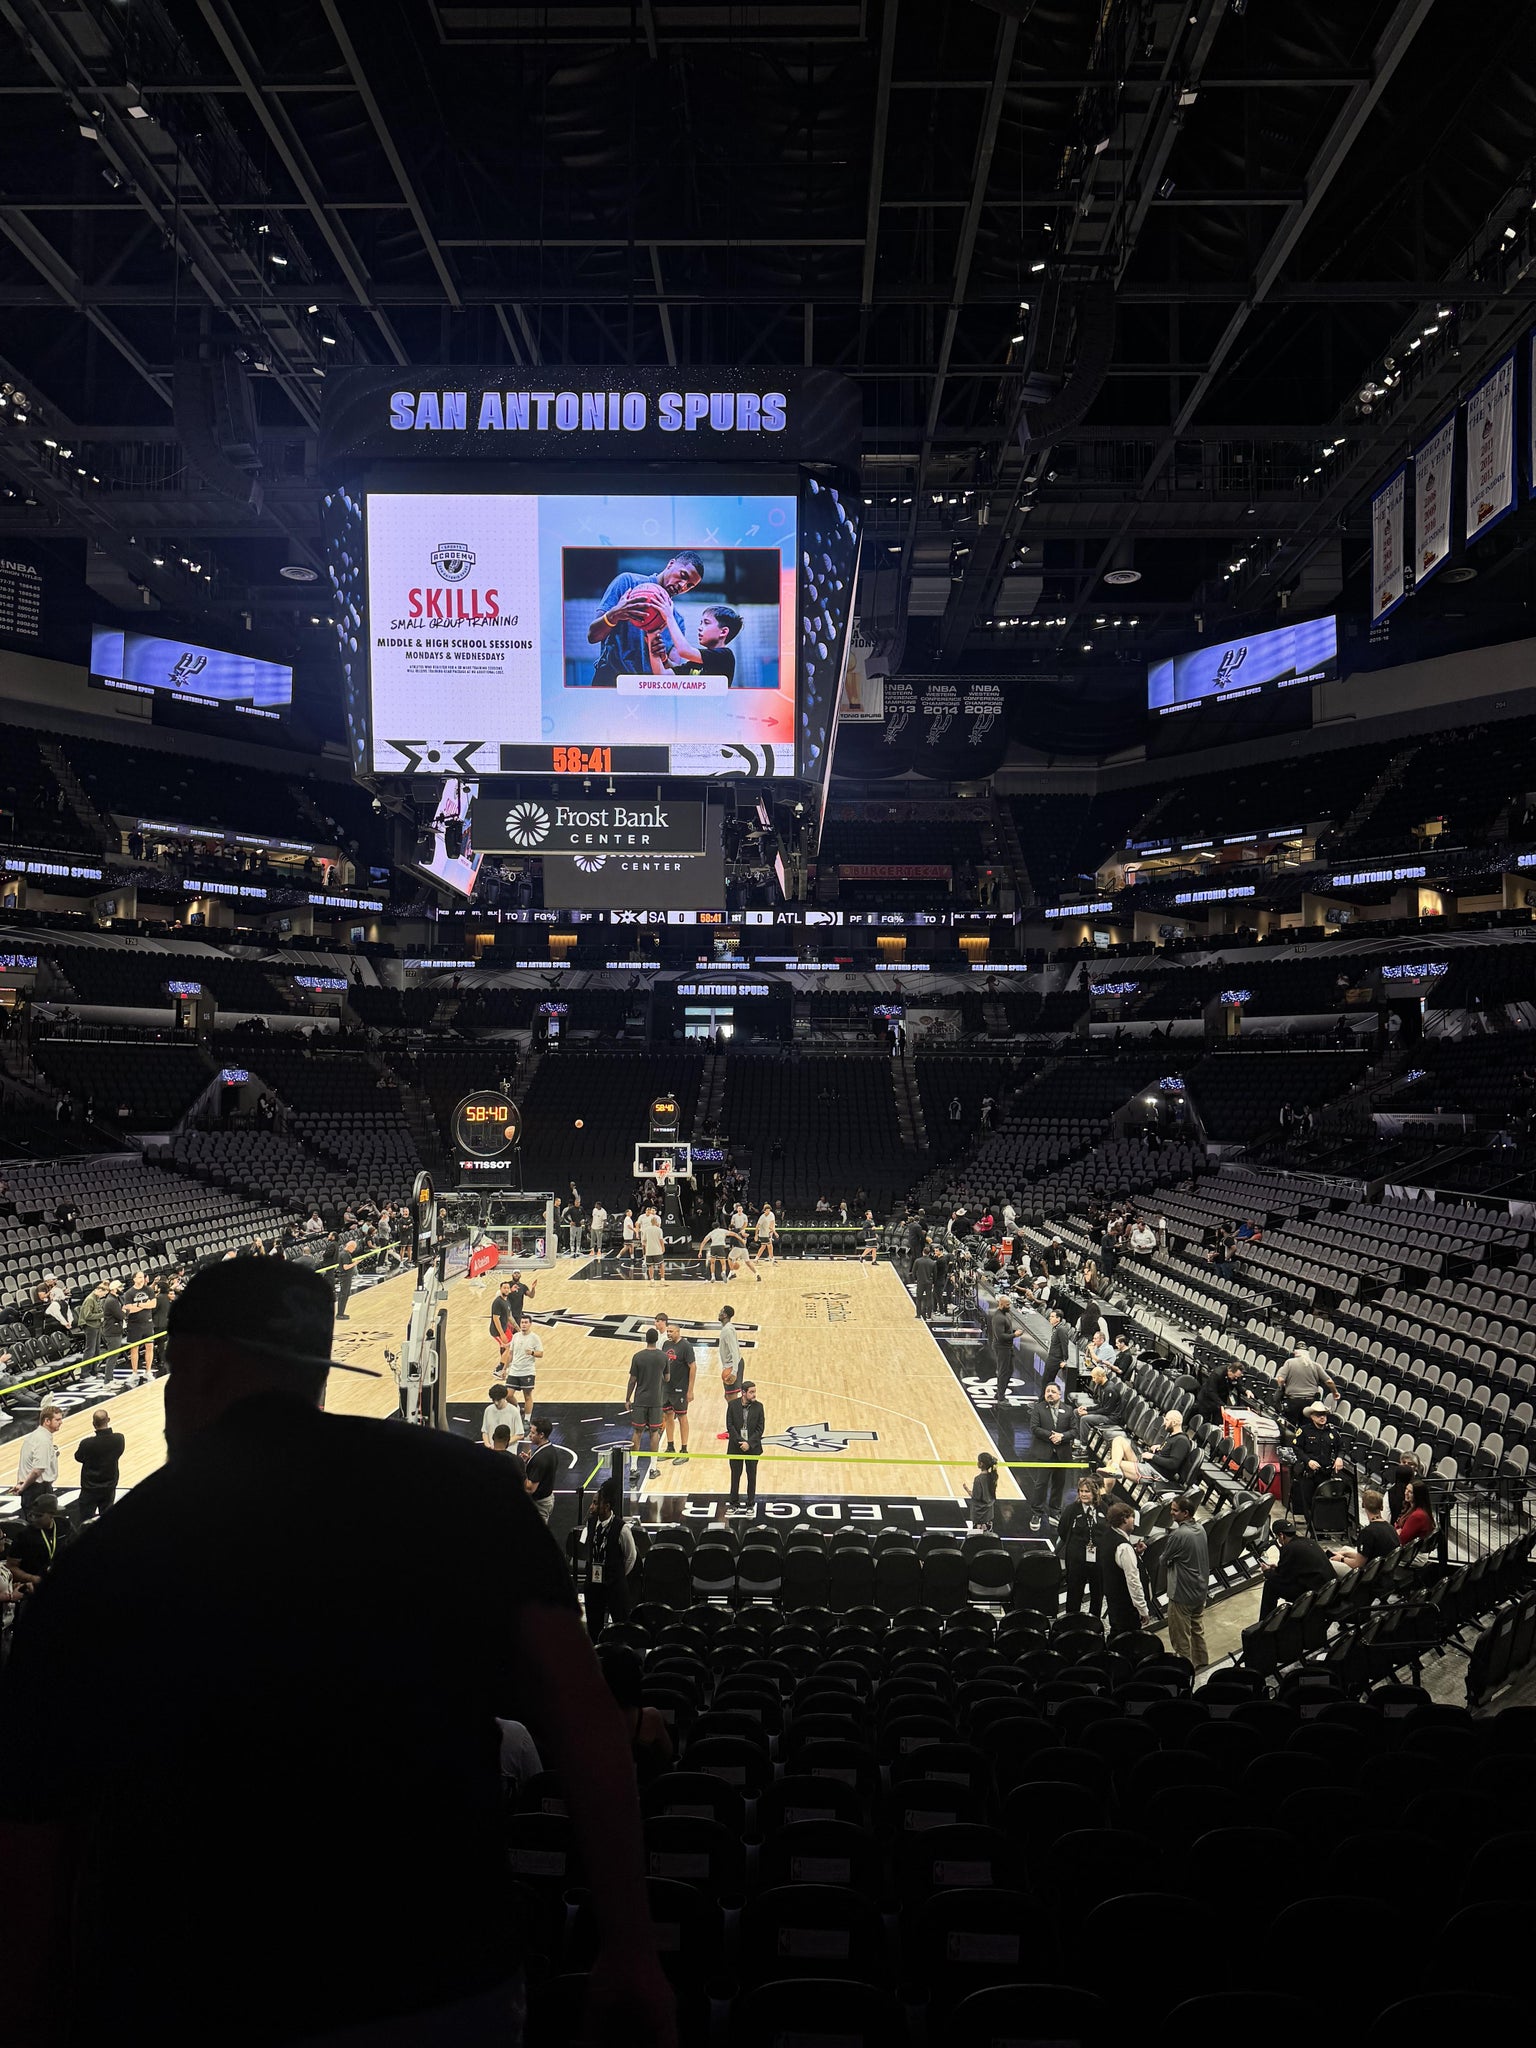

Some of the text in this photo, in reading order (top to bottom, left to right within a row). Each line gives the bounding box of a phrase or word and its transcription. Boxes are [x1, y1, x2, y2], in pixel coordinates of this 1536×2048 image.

[390, 389, 790, 435] SAN ANTONIO SPURS
[434, 552, 473, 560] ACADEMY
[6, 560, 37, 575] NBA
[408, 588, 500, 619] SKILLS
[390, 615, 519, 630] SMALL GROUP TRAINING
[377, 638, 533, 649] MIDDLE & HIGH SCHOOL SESSIONS
[405, 651, 505, 661] MONDAYS & WEDNESDAYS
[638, 681, 707, 690] SPURS.COM/CAMPS
[975, 684, 1000, 692] NBA
[923, 706, 959, 715] 2014
[964, 706, 1002, 714] 2026
[553, 747, 612, 772] 58:41
[555, 806, 669, 828] Frost Bank
[570, 834, 650, 844] CENTER
[4, 859, 103, 880] SAN ANTONIO SPURS
[621, 863, 681, 871] CENTER
[1332, 866, 1426, 887] SAN ANTONIO SPURS
[183, 880, 267, 898] SAN ANTONIO SPURS
[1175, 885, 1256, 904] SAN ANTONIO SPURS
[308, 894, 383, 912] SAN ANTONIO SPURS
[1044, 902, 1113, 918] SAN ANTONIO SPURS
[505, 913, 518, 921] TO
[534, 912, 557, 922] FG%
[580, 913, 592, 921] PF
[649, 911, 666, 924] SA
[700, 912, 722, 924] 58:41
[776, 913, 802, 924] ATL
[850, 915, 863, 923] PF
[881, 915, 904, 924] FG%
[923, 915, 936, 924] TO
[677, 984, 769, 996] SAN ANTONIO SPURS
[466, 1106, 508, 1121] 58:40
[655, 1104, 674, 1112] 58:40
[474, 1161, 511, 1169] TISSOT
[681, 1501, 924, 1521] LEDGER
